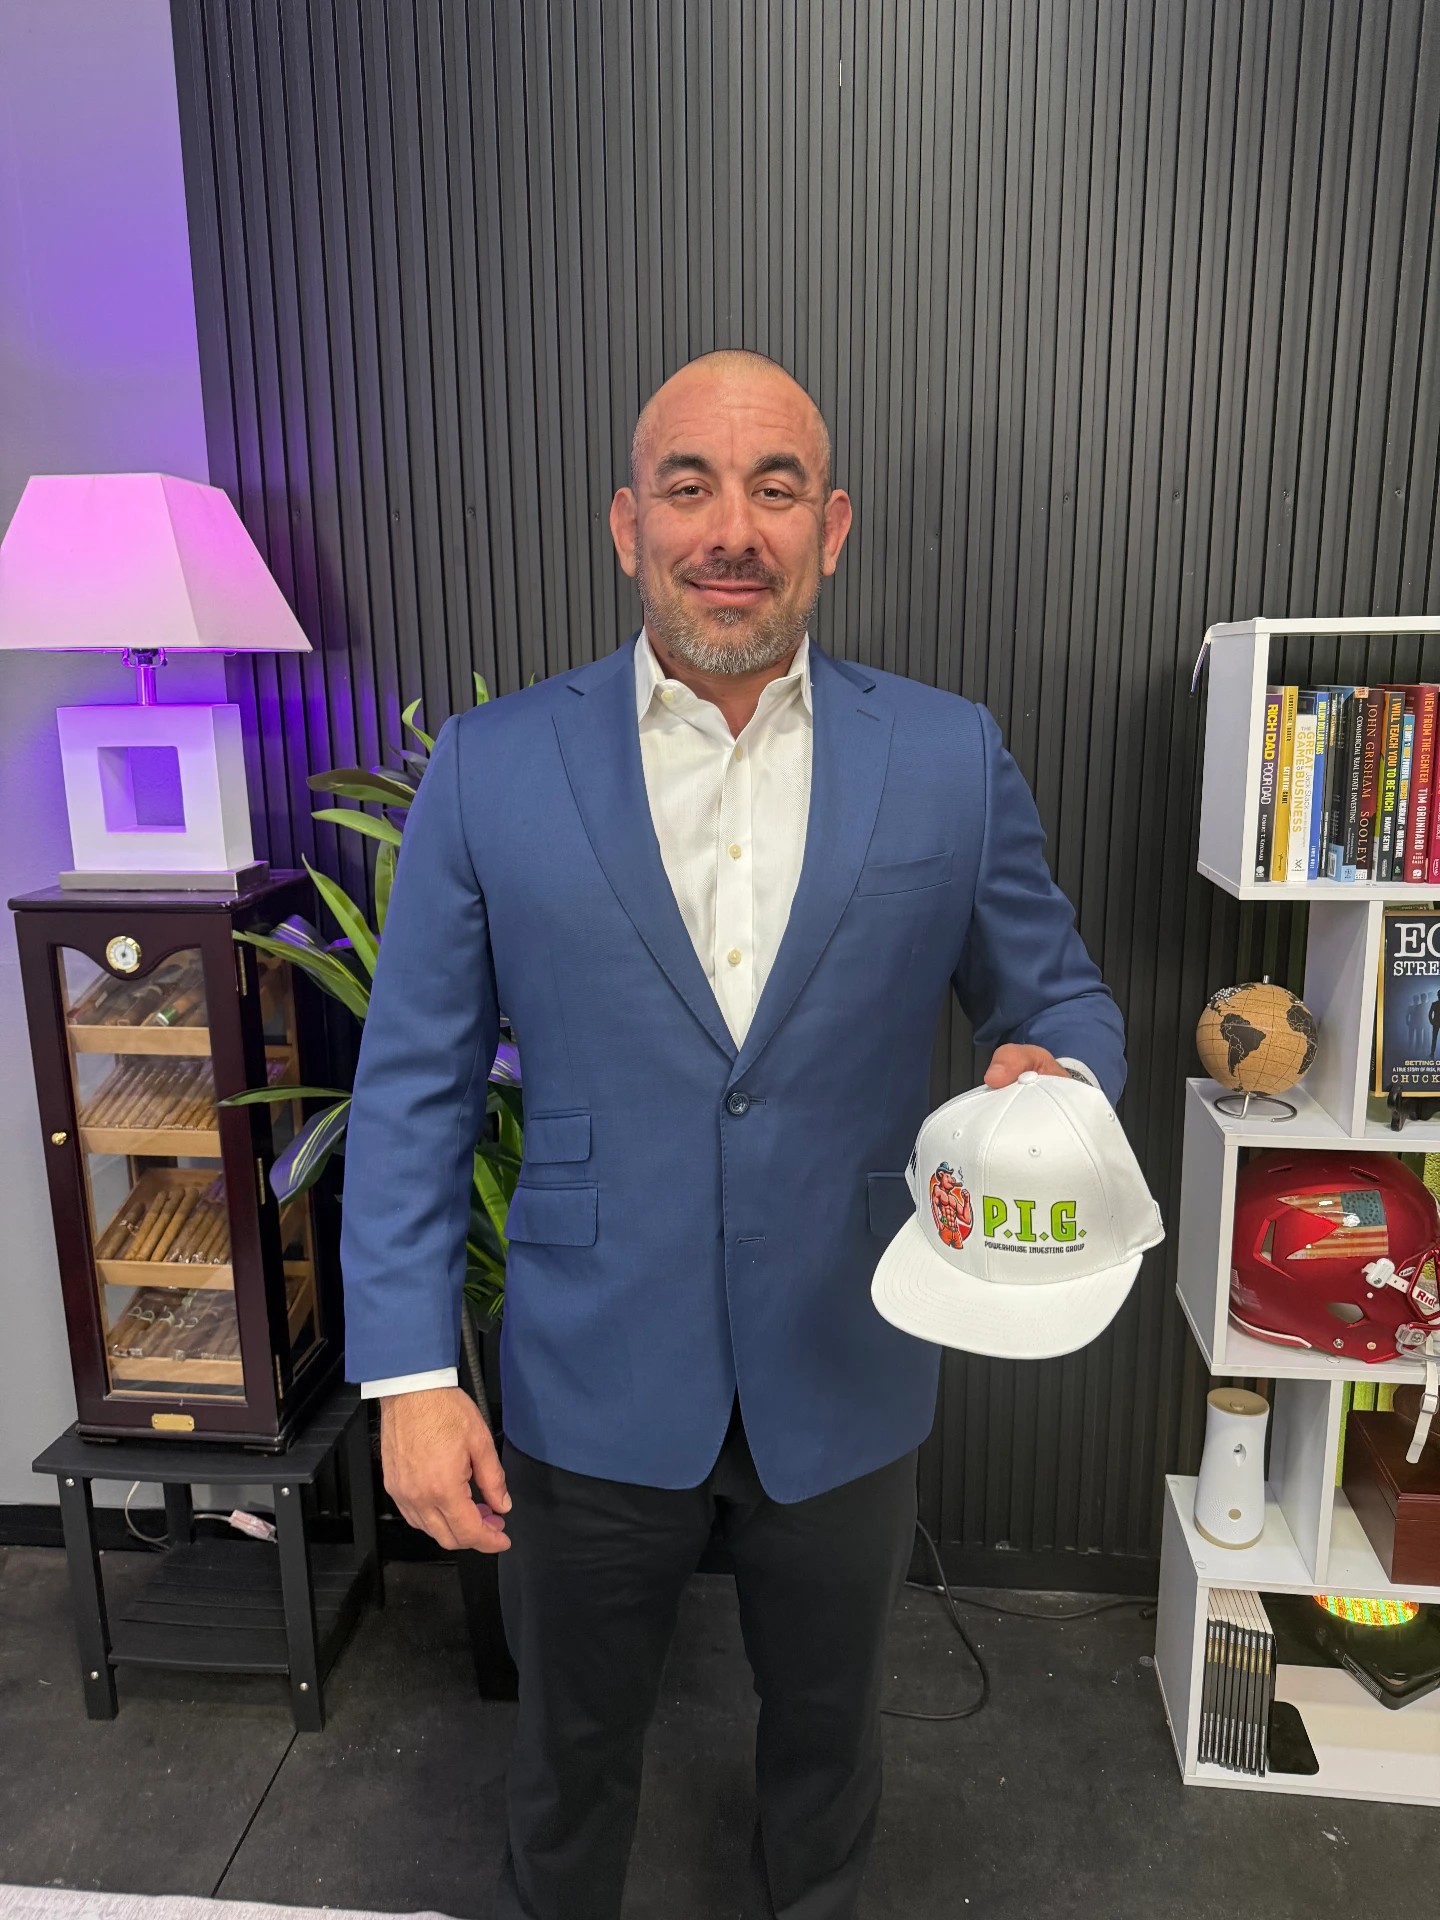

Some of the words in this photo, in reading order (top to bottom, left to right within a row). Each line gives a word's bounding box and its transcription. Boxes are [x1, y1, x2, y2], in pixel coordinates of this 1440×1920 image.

[1390, 703, 1401, 722] WILL
[1424, 692, 1435, 712] VIEW
[1267, 704, 1278, 731] RICH
[1367, 703, 1378, 737] JOHN
[1422, 714, 1433, 736] FROM
[1265, 733, 1276, 760] DAD
[1354, 716, 1363, 755] COMMERCIAL
[1389, 724, 1400, 748] TEACH
[1422, 738, 1431, 752] THE
[1296, 732, 1306, 766] GAME
[1305, 732, 1315, 770] GREAT
[1387, 750, 1398, 766] YOU
[1263, 762, 1274, 785] POOR
[1362, 742, 1375, 798] GRISHAM
[1386, 768, 1397, 778] TO
[1419, 754, 1430, 783] CENTER
[1261, 786, 1272, 804] DAD
[1385, 780, 1396, 790] BE
[1418, 788, 1428, 803] TIM
[1292, 771, 1305, 832] BUSINESS
[1349, 792, 1357, 823] INVESTING
[1384, 792, 1395, 811] RICH
[1384, 816, 1392, 834] RAMIT
[1414, 806, 1426, 850] GRUNHARD
[1356, 811, 1370, 863] SOOLEY
[1382, 835, 1390, 852] SETHI
[1394, 960, 1440, 976] STRE
[1392, 1074, 1440, 1083] CHUCK
[982, 1195, 1087, 1242] P.I.G.
[984, 1240, 1027, 1254] POWERHOUSE
[1028, 1246, 1064, 1254] INVESTING
[1066, 1243, 1086, 1254] GROUP
